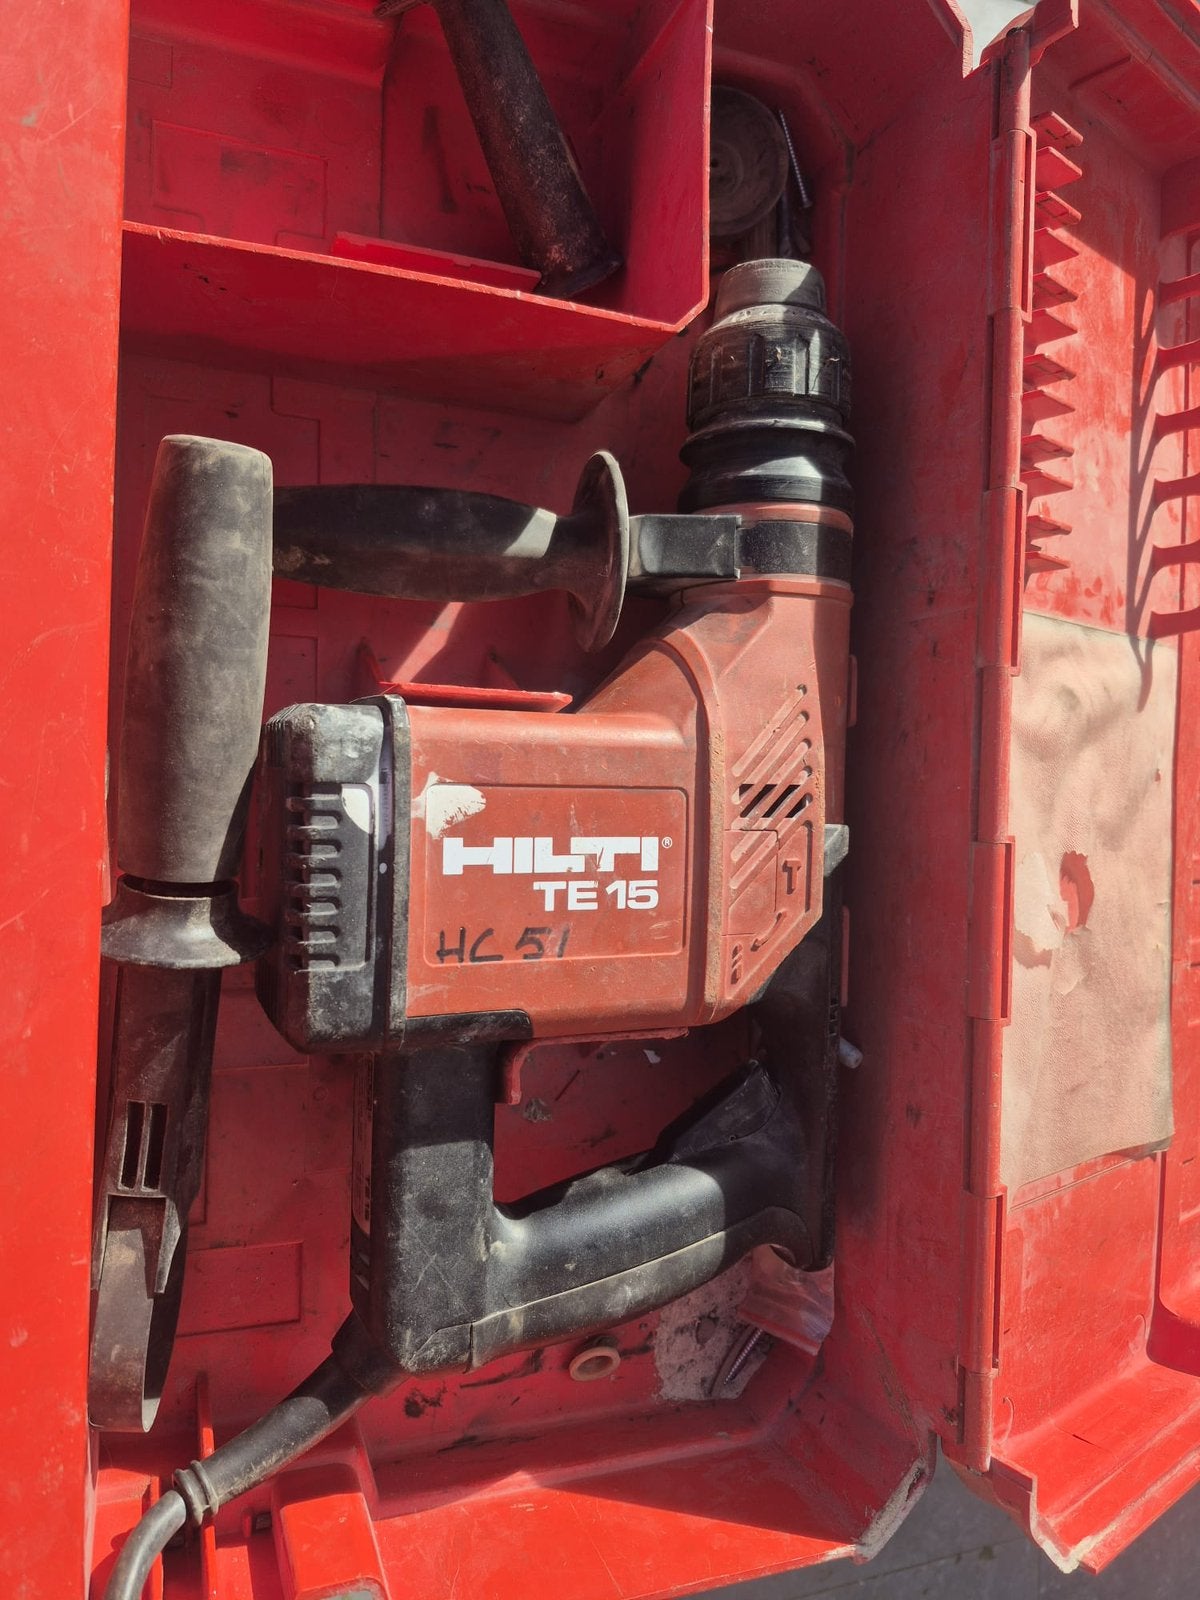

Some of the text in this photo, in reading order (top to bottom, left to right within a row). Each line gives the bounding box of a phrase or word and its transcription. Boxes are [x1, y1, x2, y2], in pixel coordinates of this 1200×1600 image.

[442, 836, 659, 875] HILTI
[532, 879, 659, 912] TE 15
[435, 926, 571, 964] HC 51
